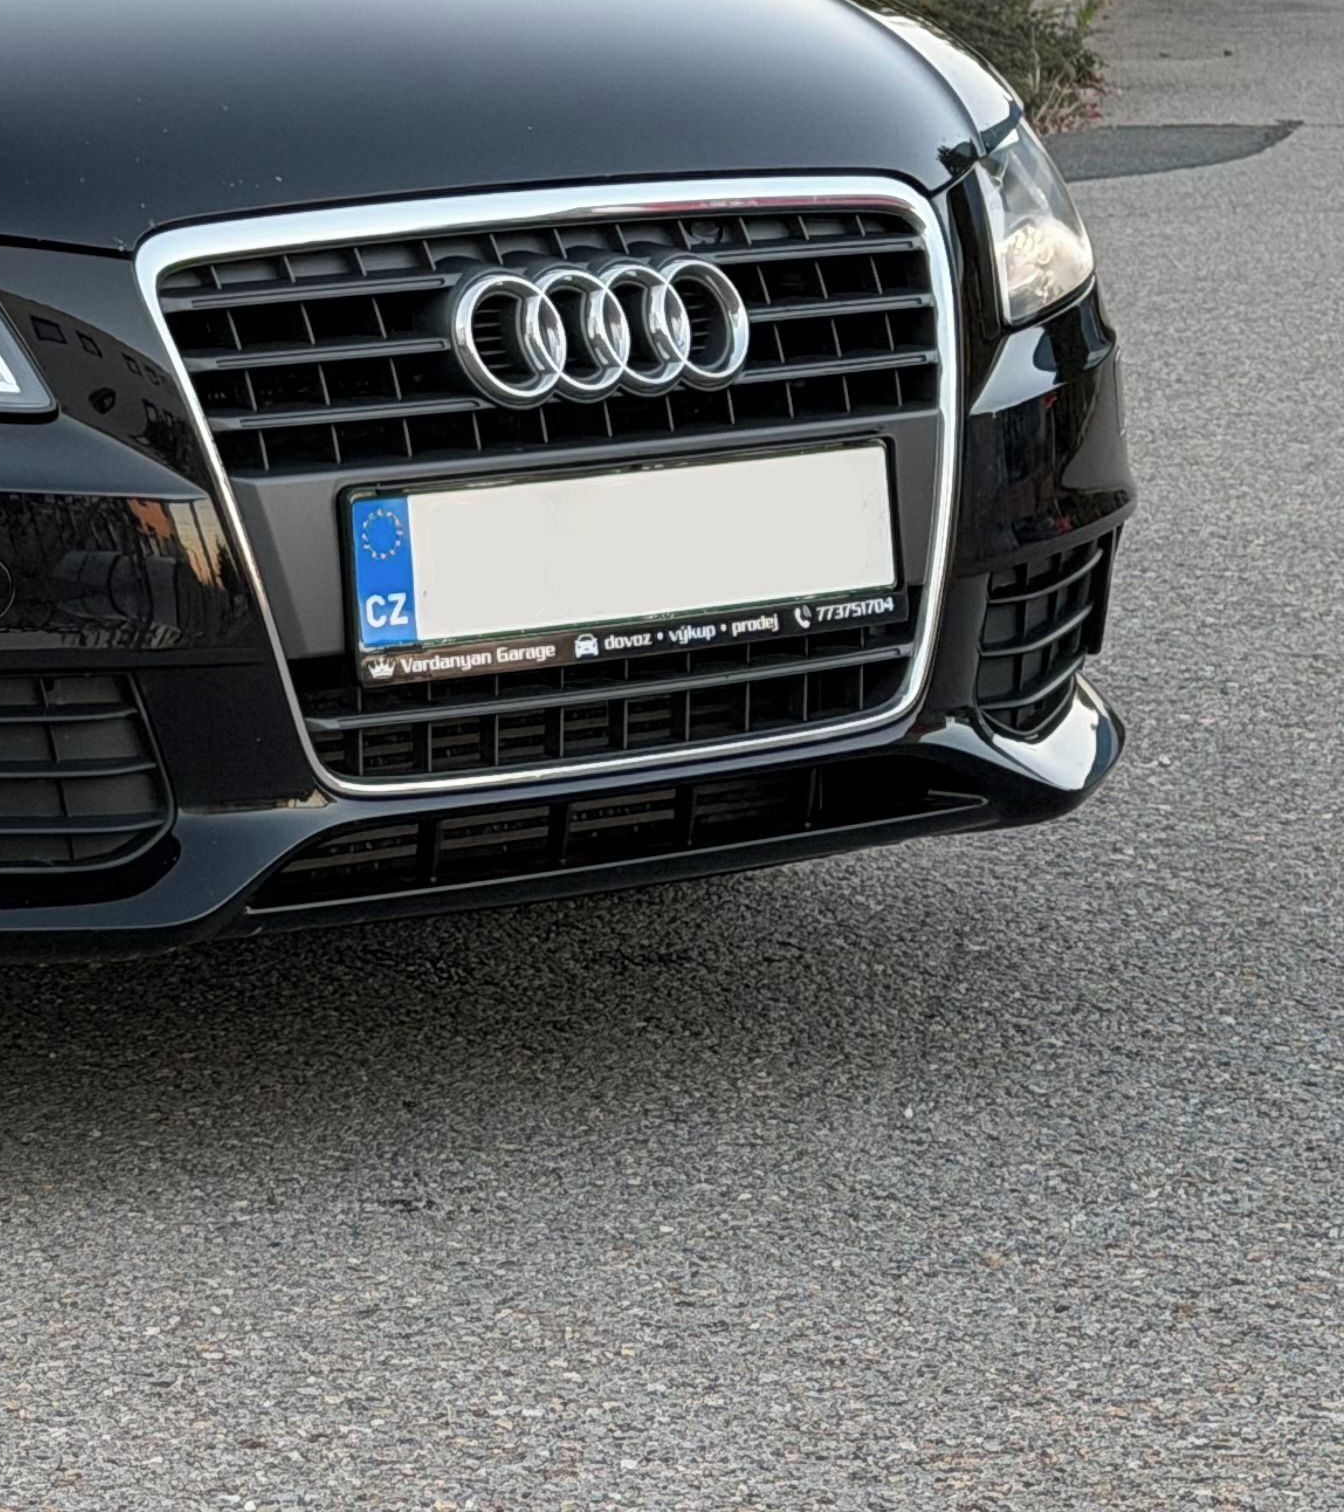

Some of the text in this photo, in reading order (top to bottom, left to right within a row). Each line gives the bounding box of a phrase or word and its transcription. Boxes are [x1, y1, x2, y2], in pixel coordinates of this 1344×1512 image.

[366, 593, 408, 628] CZ
[816, 597, 894, 622] 773751704
[604, 613, 780, 650] dovoz výkup prodej
[400, 644, 556, 673] Vardanyan Garage
